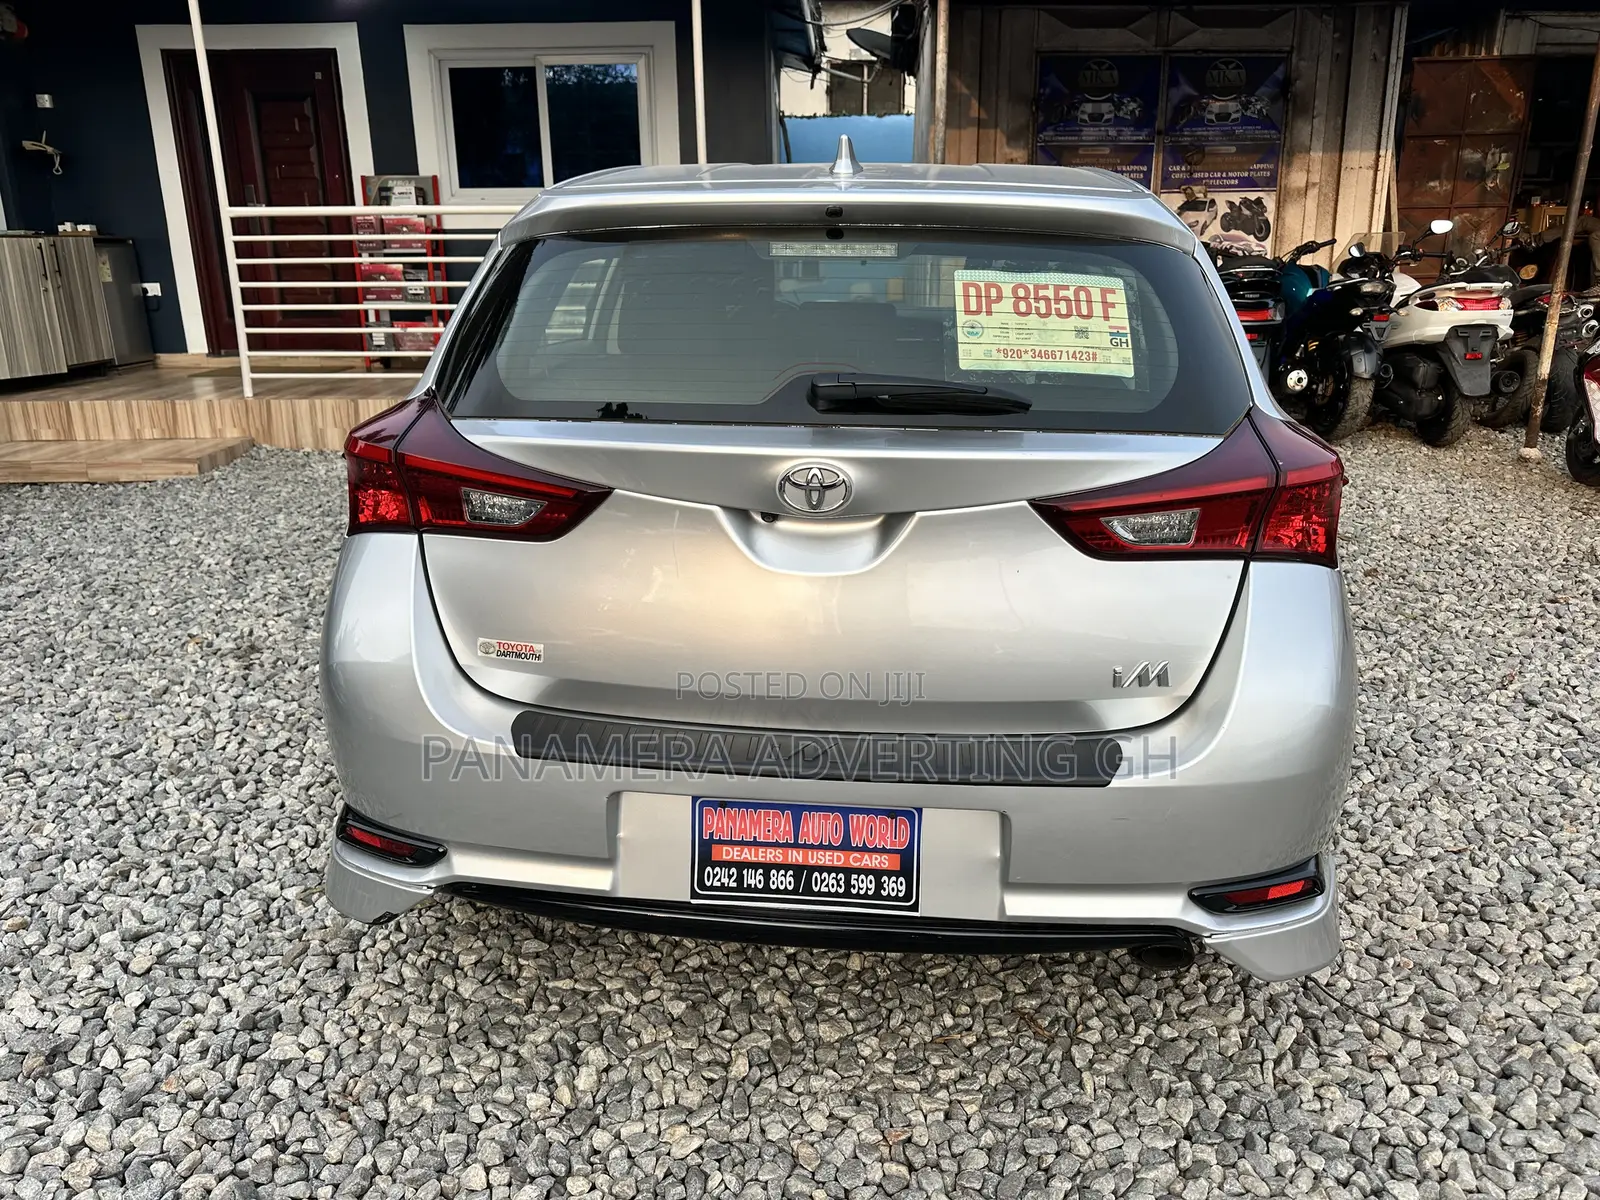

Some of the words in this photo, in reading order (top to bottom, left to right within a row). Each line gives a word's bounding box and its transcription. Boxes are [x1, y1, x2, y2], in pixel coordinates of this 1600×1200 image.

[1209, 70, 1244, 84] MKA
[962, 281, 1003, 317] DP
[1011, 283, 1094, 320] 8550
[1099, 287, 1117, 321] F
[1109, 337, 1129, 348] GH
[496, 641, 535, 653] TOYOTA
[496, 650, 541, 661] DARTMOUTH
[702, 806, 794, 843] PANAMERA
[798, 811, 844, 846] AUTO
[849, 814, 911, 850] WORLD
[722, 847, 783, 862] DEALERS
[788, 849, 803, 863] IN
[808, 851, 845, 866] USED
[849, 853, 890, 868] CARS
[704, 866, 737, 888] 0242
[742, 868, 764, 889] 146
[769, 869, 795, 891] 866
[799, 870, 807, 893] /
[811, 871, 845, 894] 0263
[850, 874, 876, 895] 599
[880, 876, 906, 897] 369
